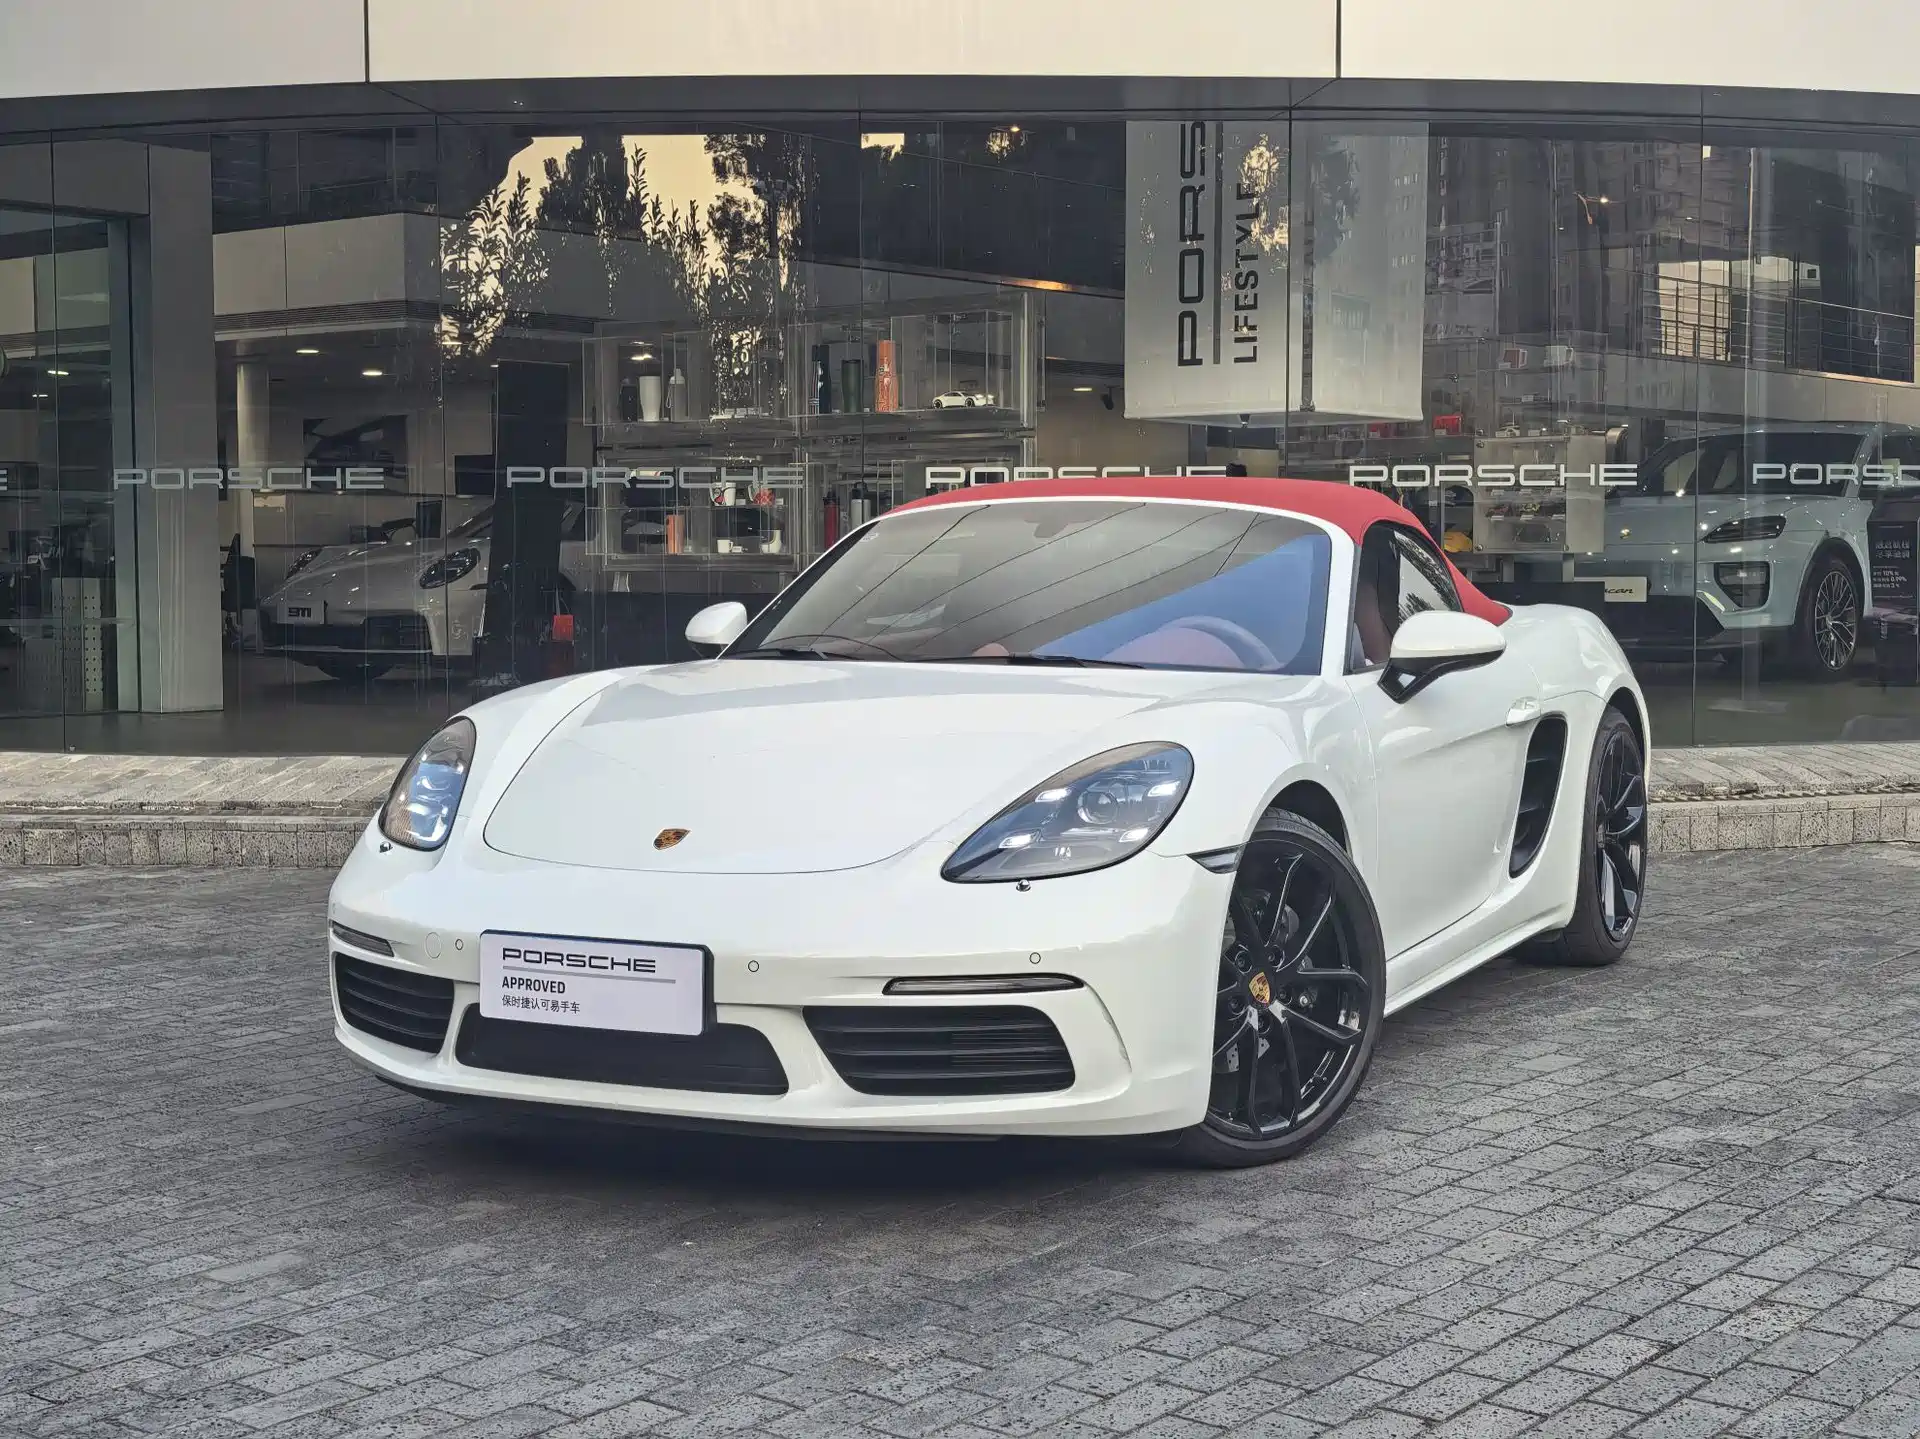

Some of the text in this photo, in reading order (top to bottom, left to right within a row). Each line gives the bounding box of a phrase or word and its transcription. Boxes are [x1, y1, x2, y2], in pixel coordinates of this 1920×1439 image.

[114, 467, 385, 490] PORSCHE
[506, 466, 804, 489] PORSCHE
[1349, 463, 1638, 487] PORSCHE
[288, 607, 312, 618] 911
[502, 947, 656, 974] PORSCHE
[502, 976, 566, 994] APPROVED
[502, 994, 580, 1014] 保时捷认可易手车
